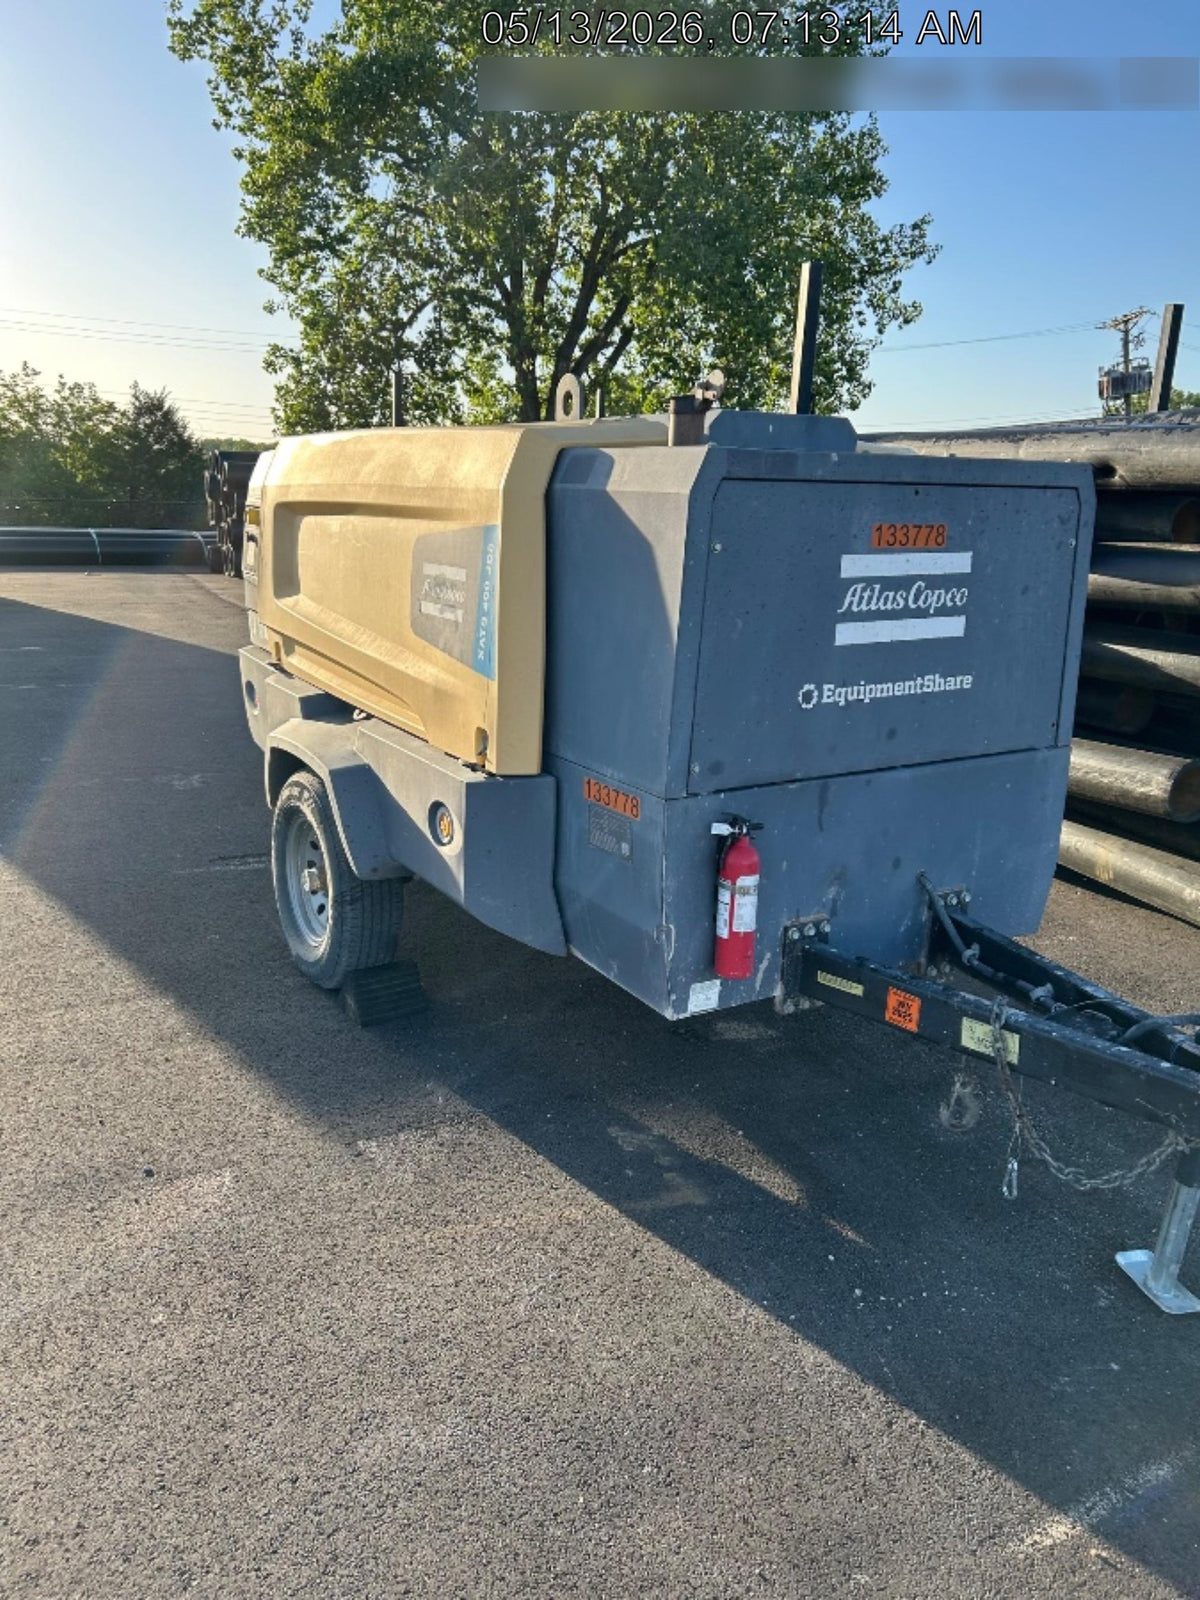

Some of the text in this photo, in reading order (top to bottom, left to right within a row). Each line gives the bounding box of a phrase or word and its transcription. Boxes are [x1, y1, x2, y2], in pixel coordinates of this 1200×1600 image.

[874, 524, 947, 547] 133778
[821, 672, 973, 706] EquipmentShare
[585, 778, 640, 818] 133778
